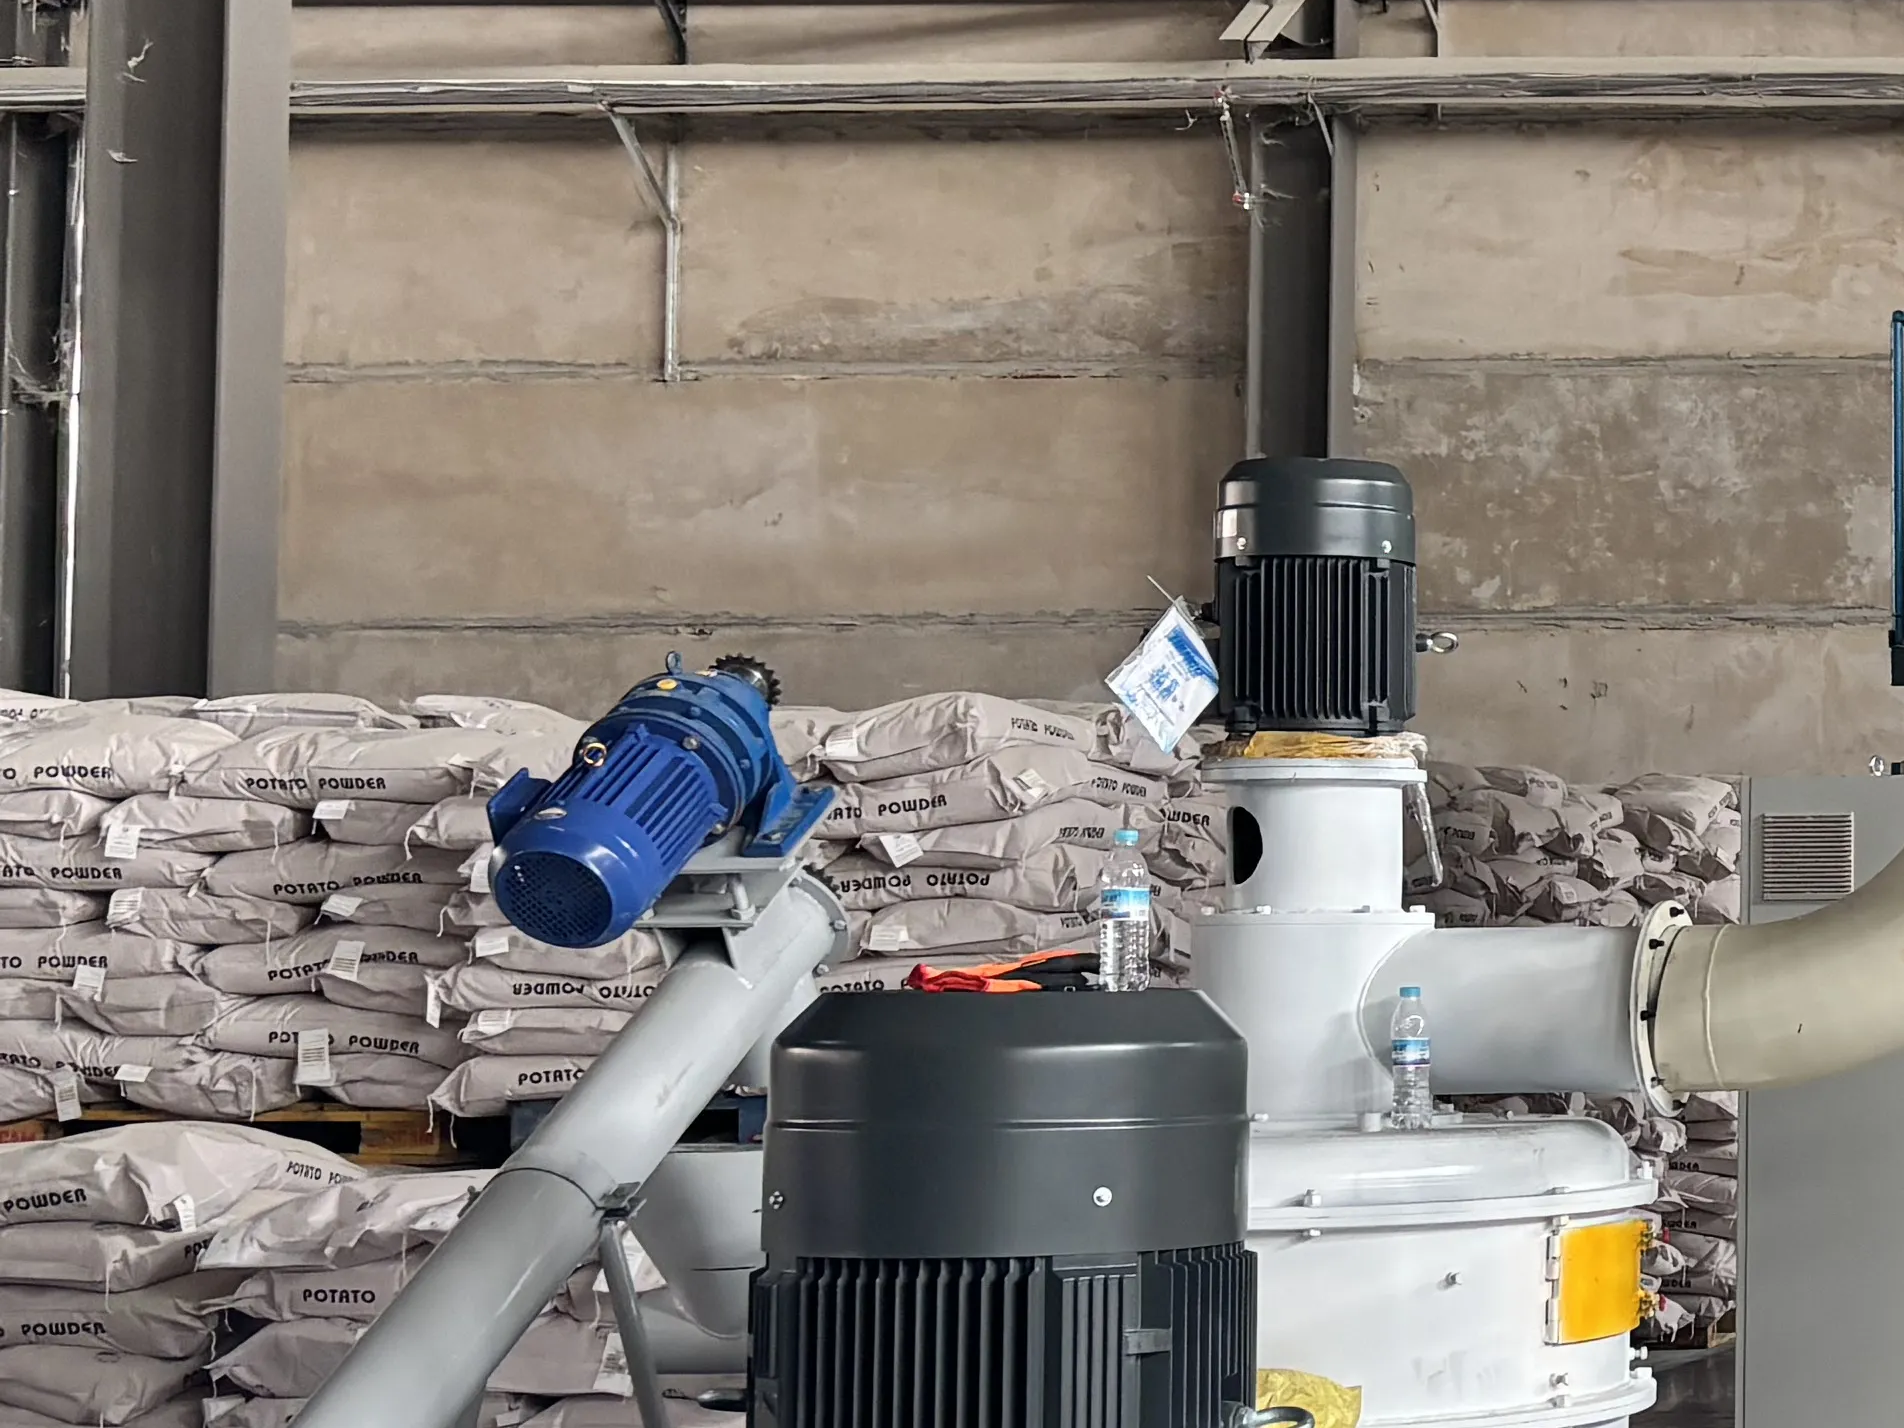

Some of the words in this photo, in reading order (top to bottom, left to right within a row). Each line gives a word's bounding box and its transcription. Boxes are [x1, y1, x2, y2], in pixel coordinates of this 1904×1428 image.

[34, 765, 112, 780] POWDER
[245, 777, 308, 791] POTATO
[318, 777, 386, 790] POWDER
[878, 794, 947, 817] POWDER
[51, 867, 122, 880] POWDER
[926, 874, 990, 886] POTATO
[273, 880, 340, 895] POTATO
[353, 872, 423, 887] POWDER
[841, 876, 911, 893] POWDER
[37, 956, 108, 969] POWDER
[513, 982, 584, 995] POWDER
[600, 985, 657, 998] OTATO
[349, 1035, 420, 1054] POWDER
[286, 1160, 322, 1180] POTATO
[4, 1188, 87, 1212] POWDER
[303, 1289, 375, 1302] POTATO
[22, 1322, 106, 1336] POWDER
